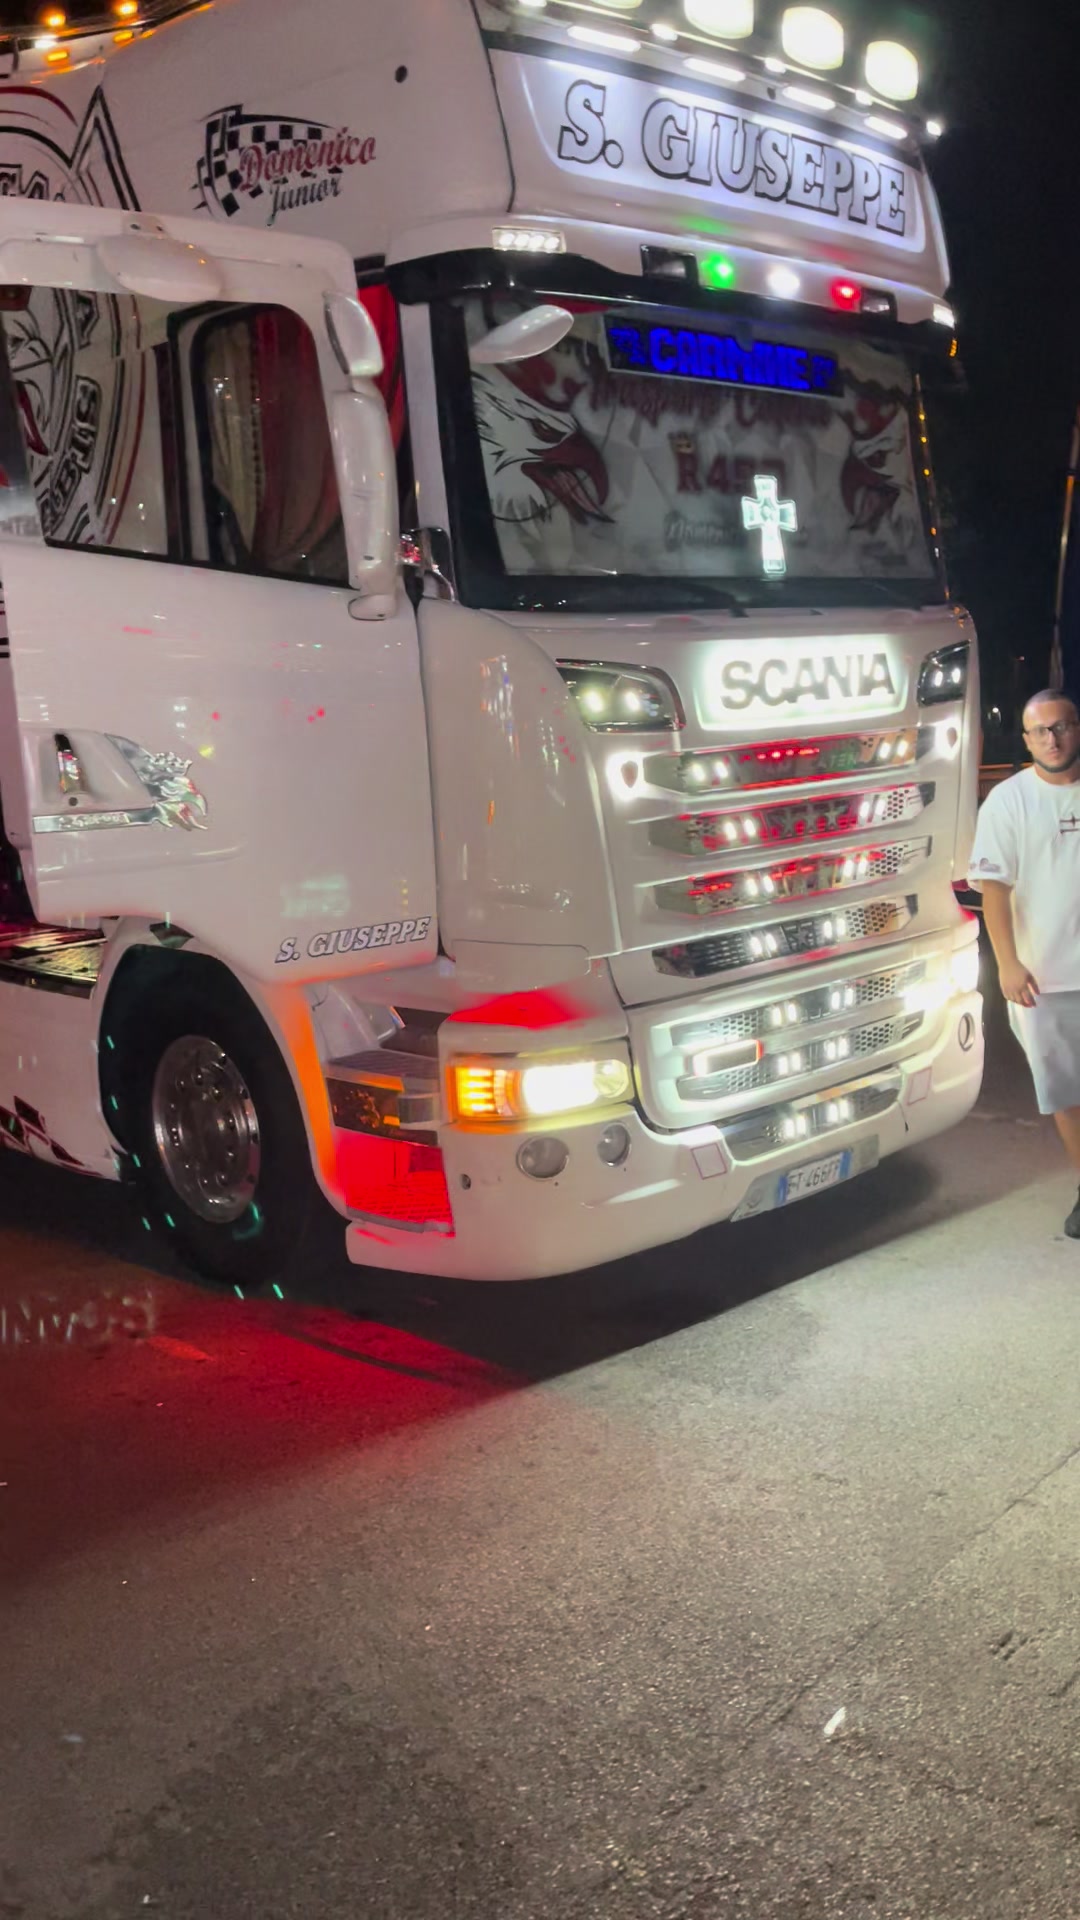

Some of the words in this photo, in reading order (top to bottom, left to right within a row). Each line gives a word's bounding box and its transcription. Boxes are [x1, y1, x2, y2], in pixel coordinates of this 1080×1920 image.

[239, 127, 376, 193] Domenico
[557, 79, 624, 169] S.
[641, 97, 906, 237] GIUSEPPE
[720, 652, 895, 711] SCANIA
[275, 937, 301, 963] S.
[308, 916, 432, 957] GIUSEPPE
